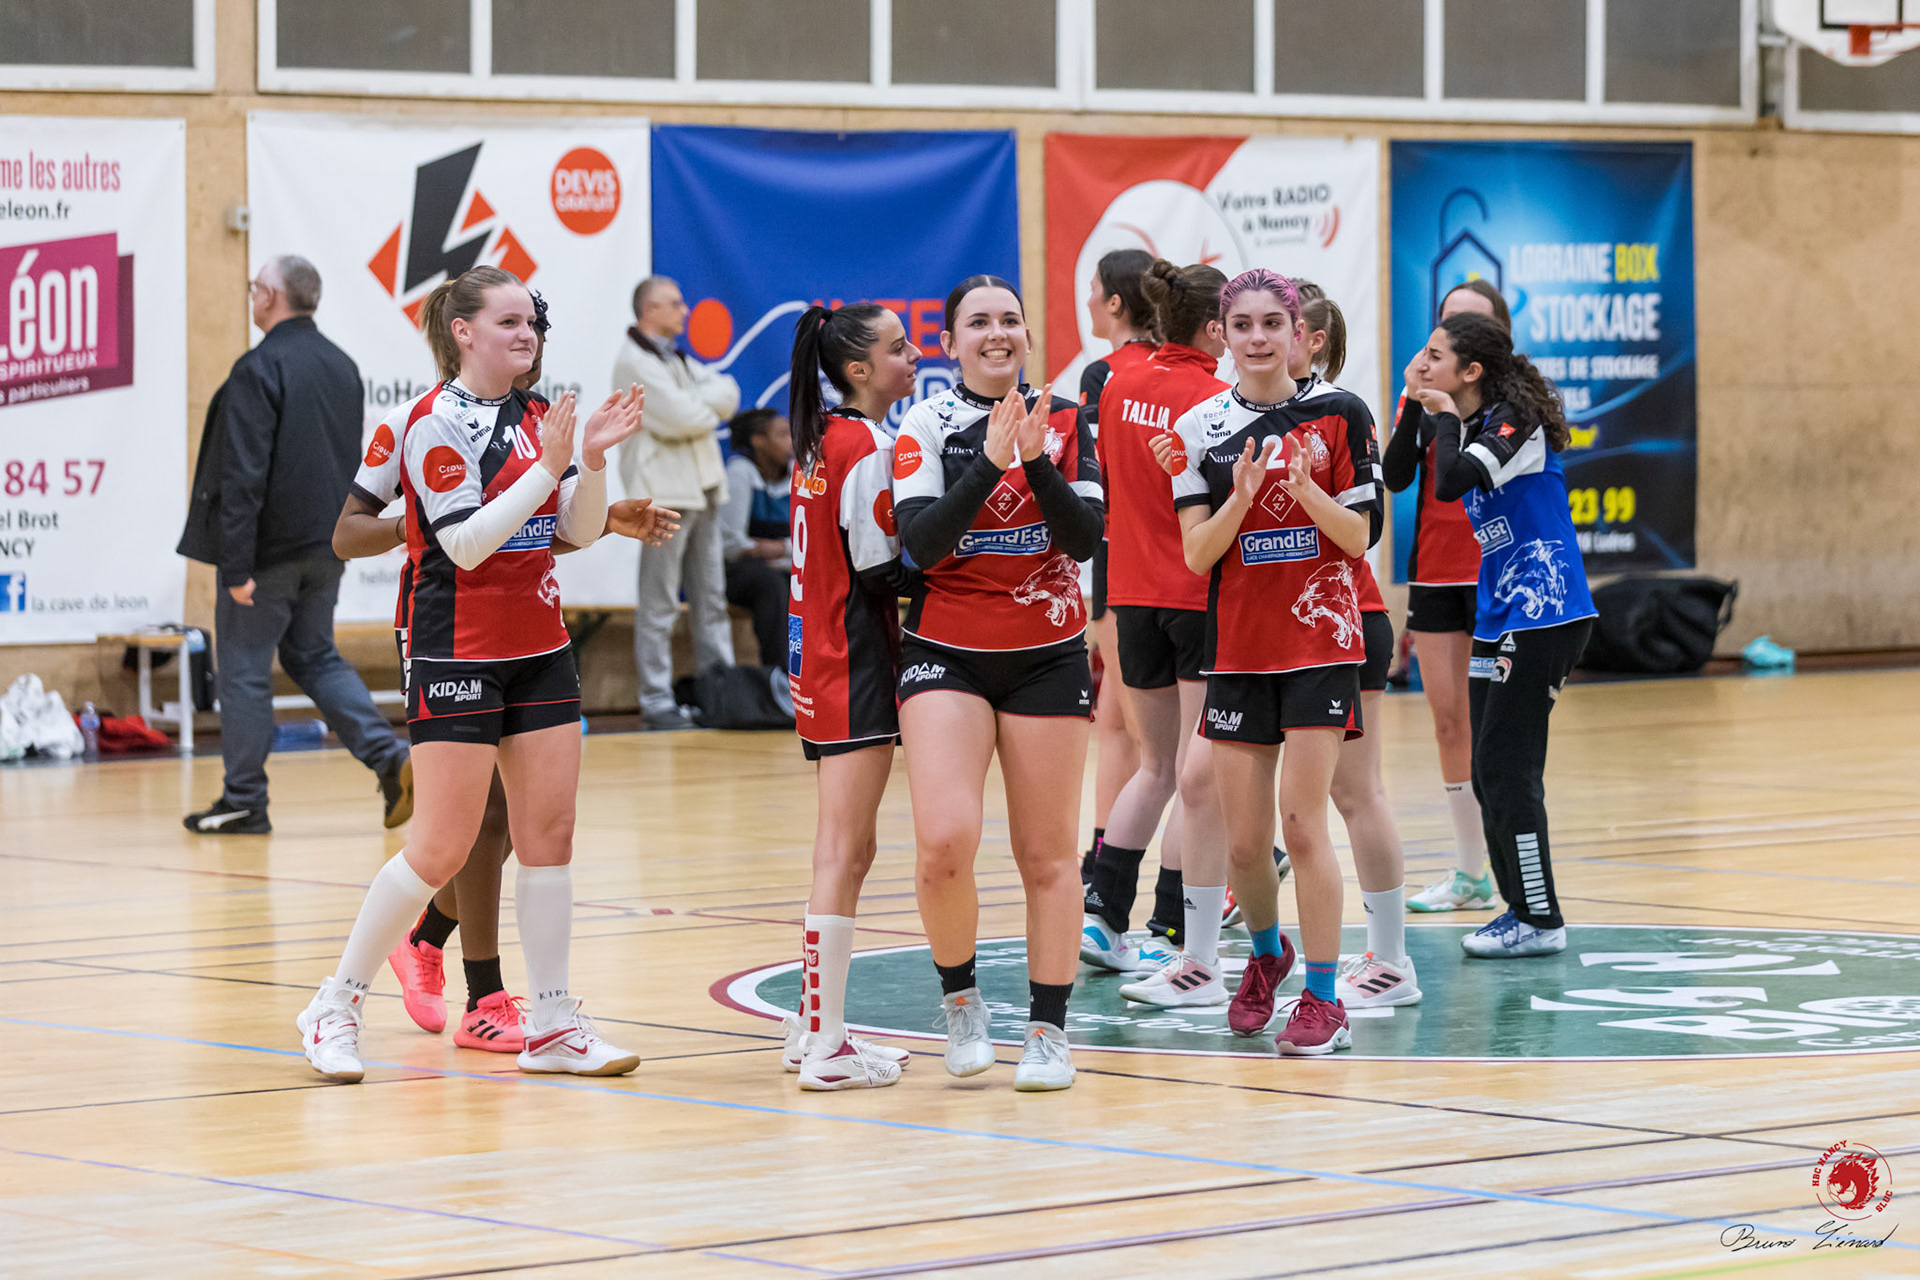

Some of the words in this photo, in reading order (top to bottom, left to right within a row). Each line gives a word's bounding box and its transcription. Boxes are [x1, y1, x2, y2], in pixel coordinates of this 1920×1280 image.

[29, 150, 56, 190] les
[62, 152, 120, 192] autres
[556, 168, 616, 194] DEVIS
[1218, 190, 1267, 211] Votre
[1273, 184, 1330, 206] RADIO
[1258, 214, 1310, 236] Nancy
[1509, 243, 1612, 283] LORRAINE
[1615, 243, 1660, 282] BOX
[0, 249, 98, 361] éon
[1530, 292, 1662, 342] STOCKAGE
[1591, 354, 1661, 380] STOCKAGE
[1121, 398, 1170, 430] TALLIA
[470, 425, 492, 442] erima
[502, 424, 537, 460] 10
[372, 440, 392, 458] Crous
[898, 450, 923, 462] Crous
[1262, 434, 1286, 470] 2
[5, 460, 49, 496] 84
[63, 460, 105, 496] 57
[438, 463, 467, 474] Crous
[1568, 488, 1599, 525] 23
[1603, 486, 1637, 523] 99
[18, 509, 59, 531] Brot
[790, 504, 808, 601] 9
[428, 679, 482, 699] KIDAM
[915, 672, 943, 683] SPORT
[454, 692, 482, 703] SPORT
[1214, 722, 1239, 732] SPORT
